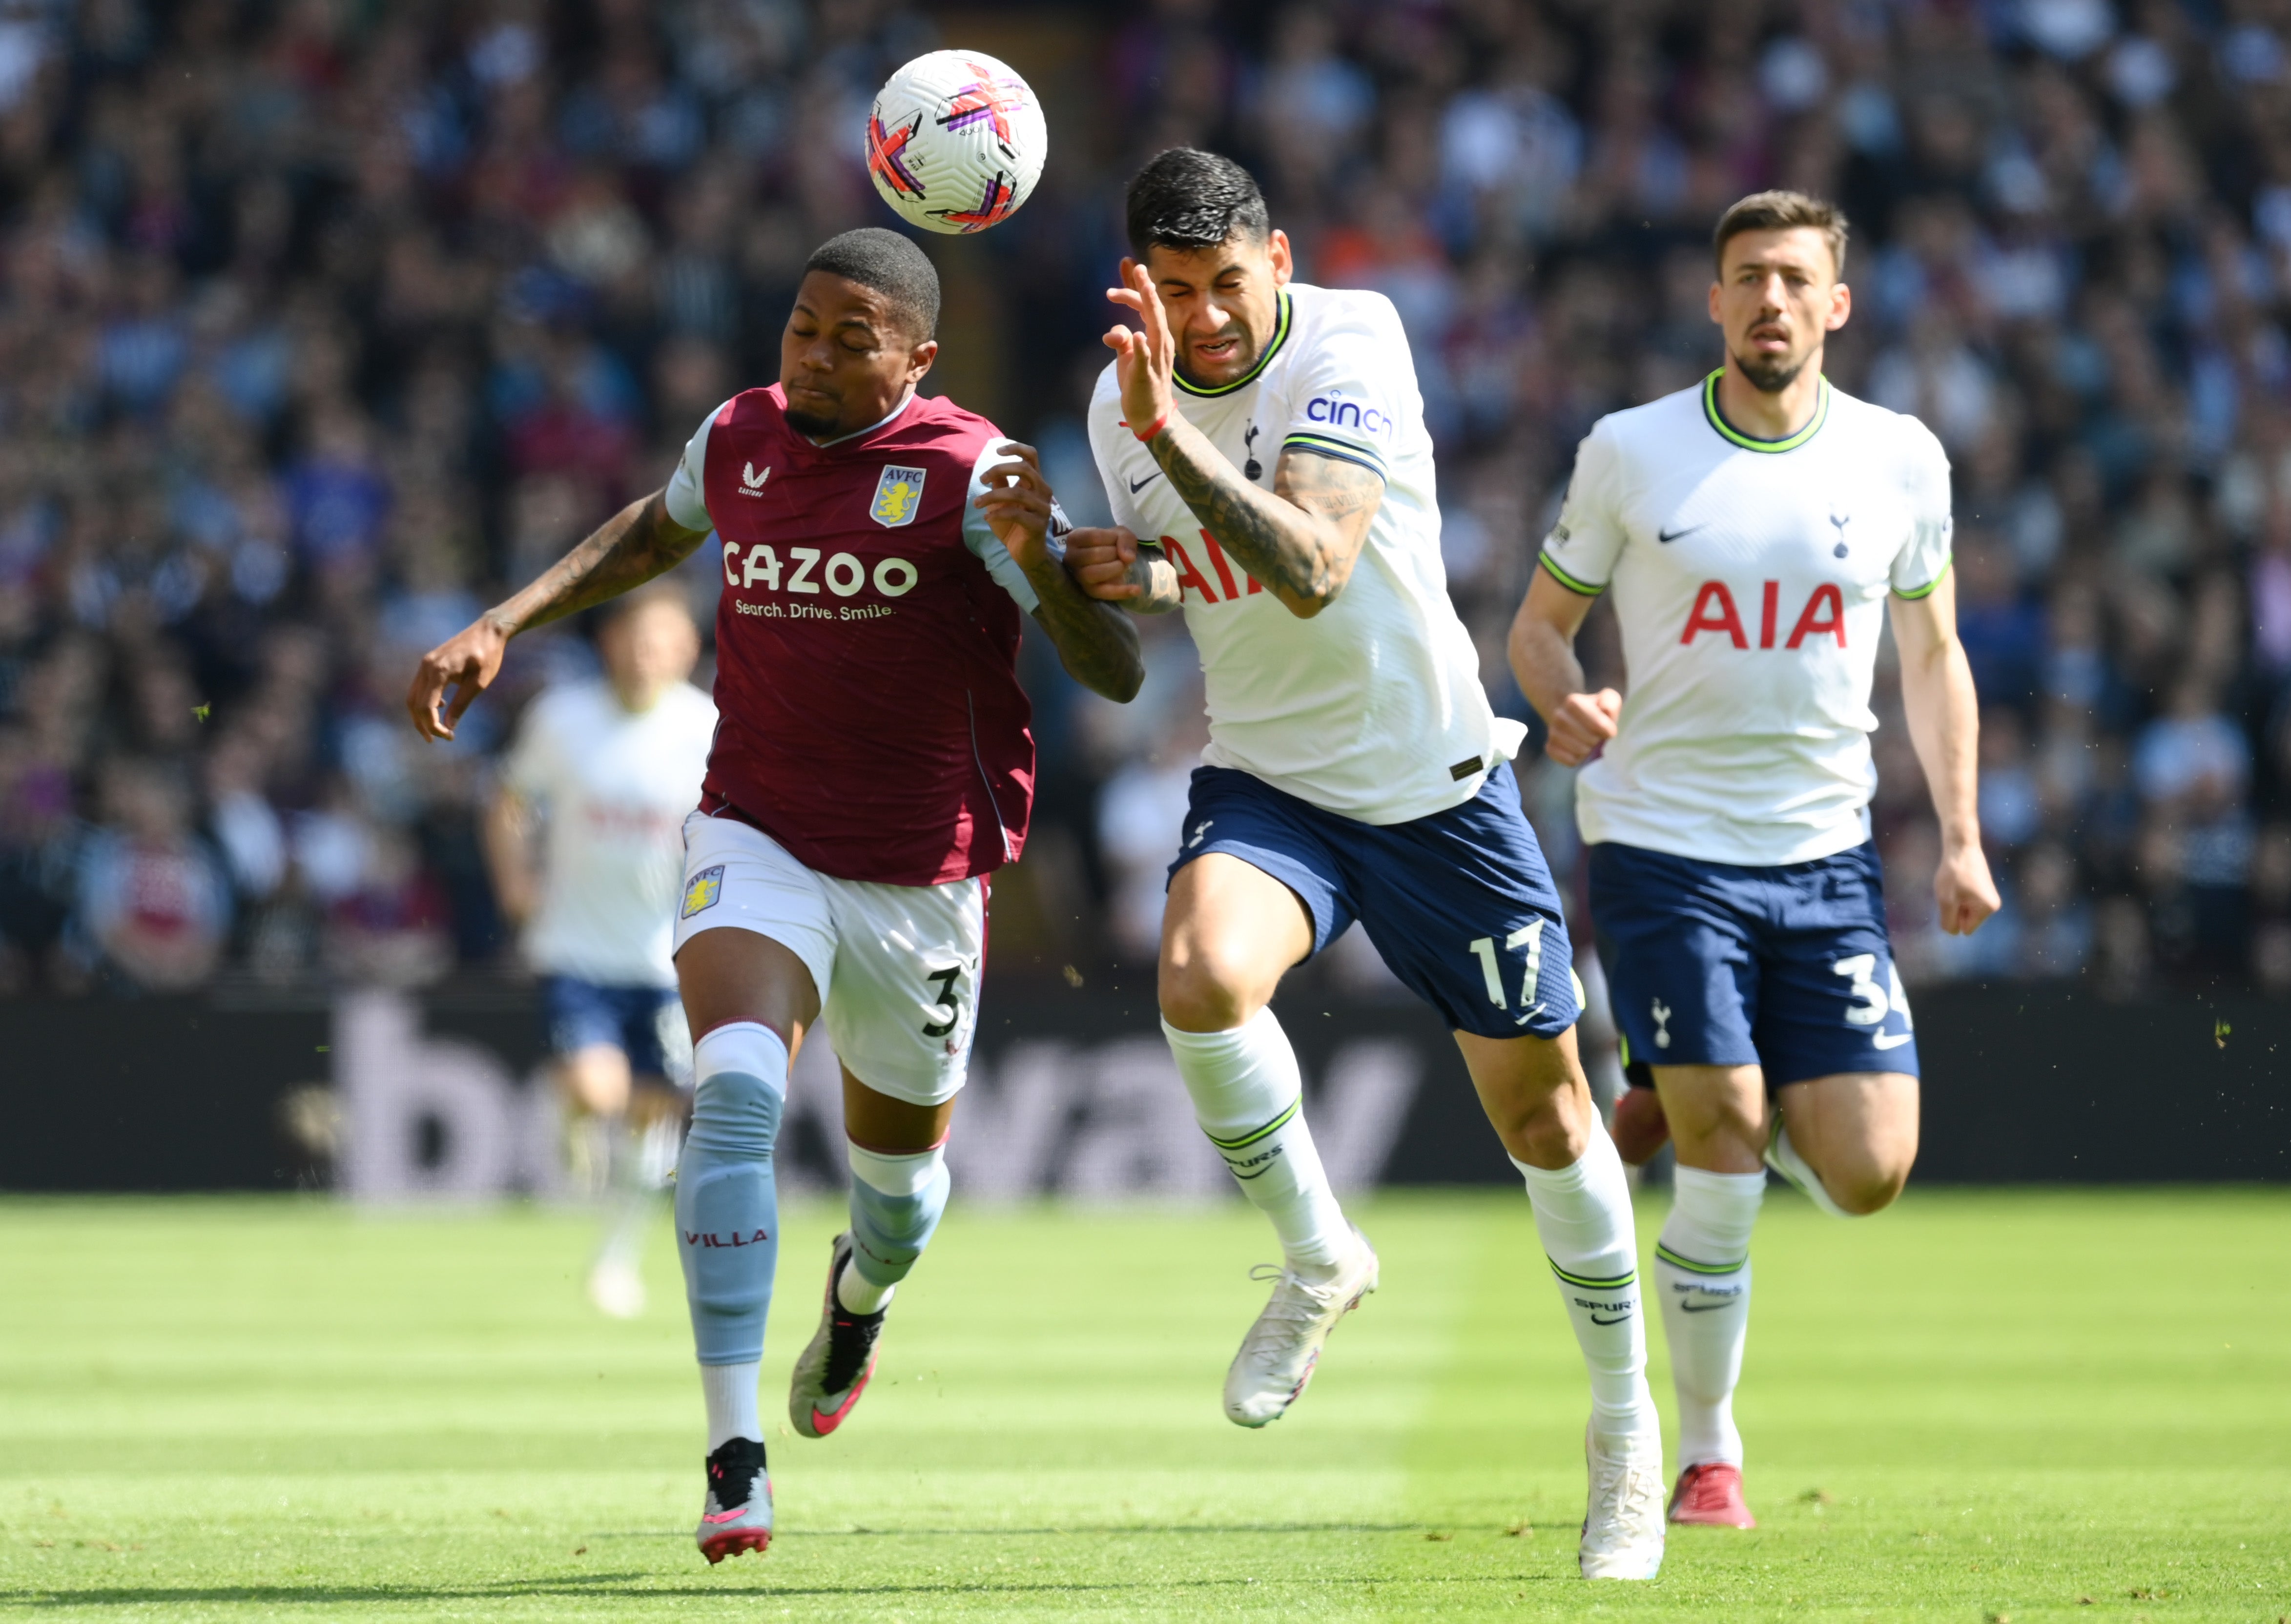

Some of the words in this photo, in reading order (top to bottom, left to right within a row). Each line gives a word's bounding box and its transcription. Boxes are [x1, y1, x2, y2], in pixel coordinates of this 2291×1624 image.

[1307, 390, 1393, 443] cinch
[885, 469, 923, 483] AVFC
[723, 541, 918, 596] CAZOO
[736, 599, 786, 617] Search.
[789, 603, 837, 619] Drive.
[840, 605, 897, 620] Smile.
[1680, 579, 1847, 650] AIA
[1469, 918, 1544, 1010] 17
[685, 1229, 767, 1248] VILLA
[1574, 1296, 1636, 1312] SPUR
